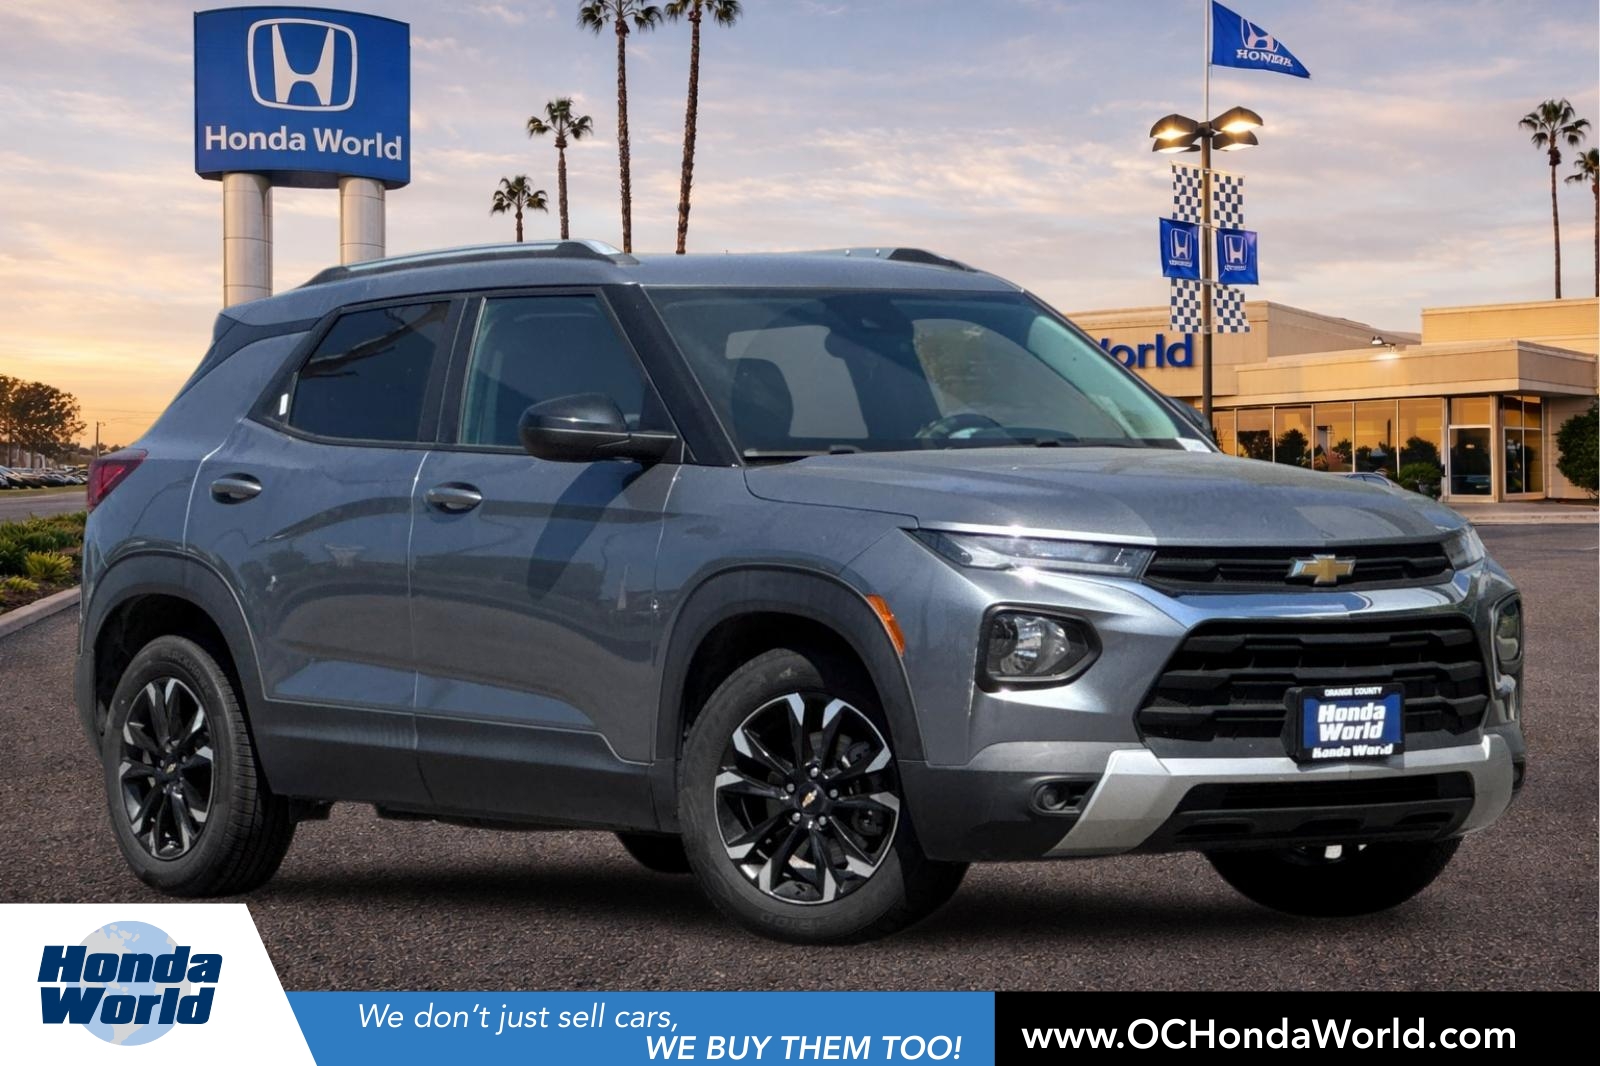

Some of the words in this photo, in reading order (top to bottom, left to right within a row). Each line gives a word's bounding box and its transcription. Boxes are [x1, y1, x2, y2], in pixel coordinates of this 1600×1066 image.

[205, 125, 306, 151] Honda
[313, 127, 402, 160] World
[1324, 688, 1353, 697] ORANGE
[1354, 686, 1383, 696] COUNTY
[1318, 702, 1386, 723] Honda
[1319, 720, 1385, 742] World
